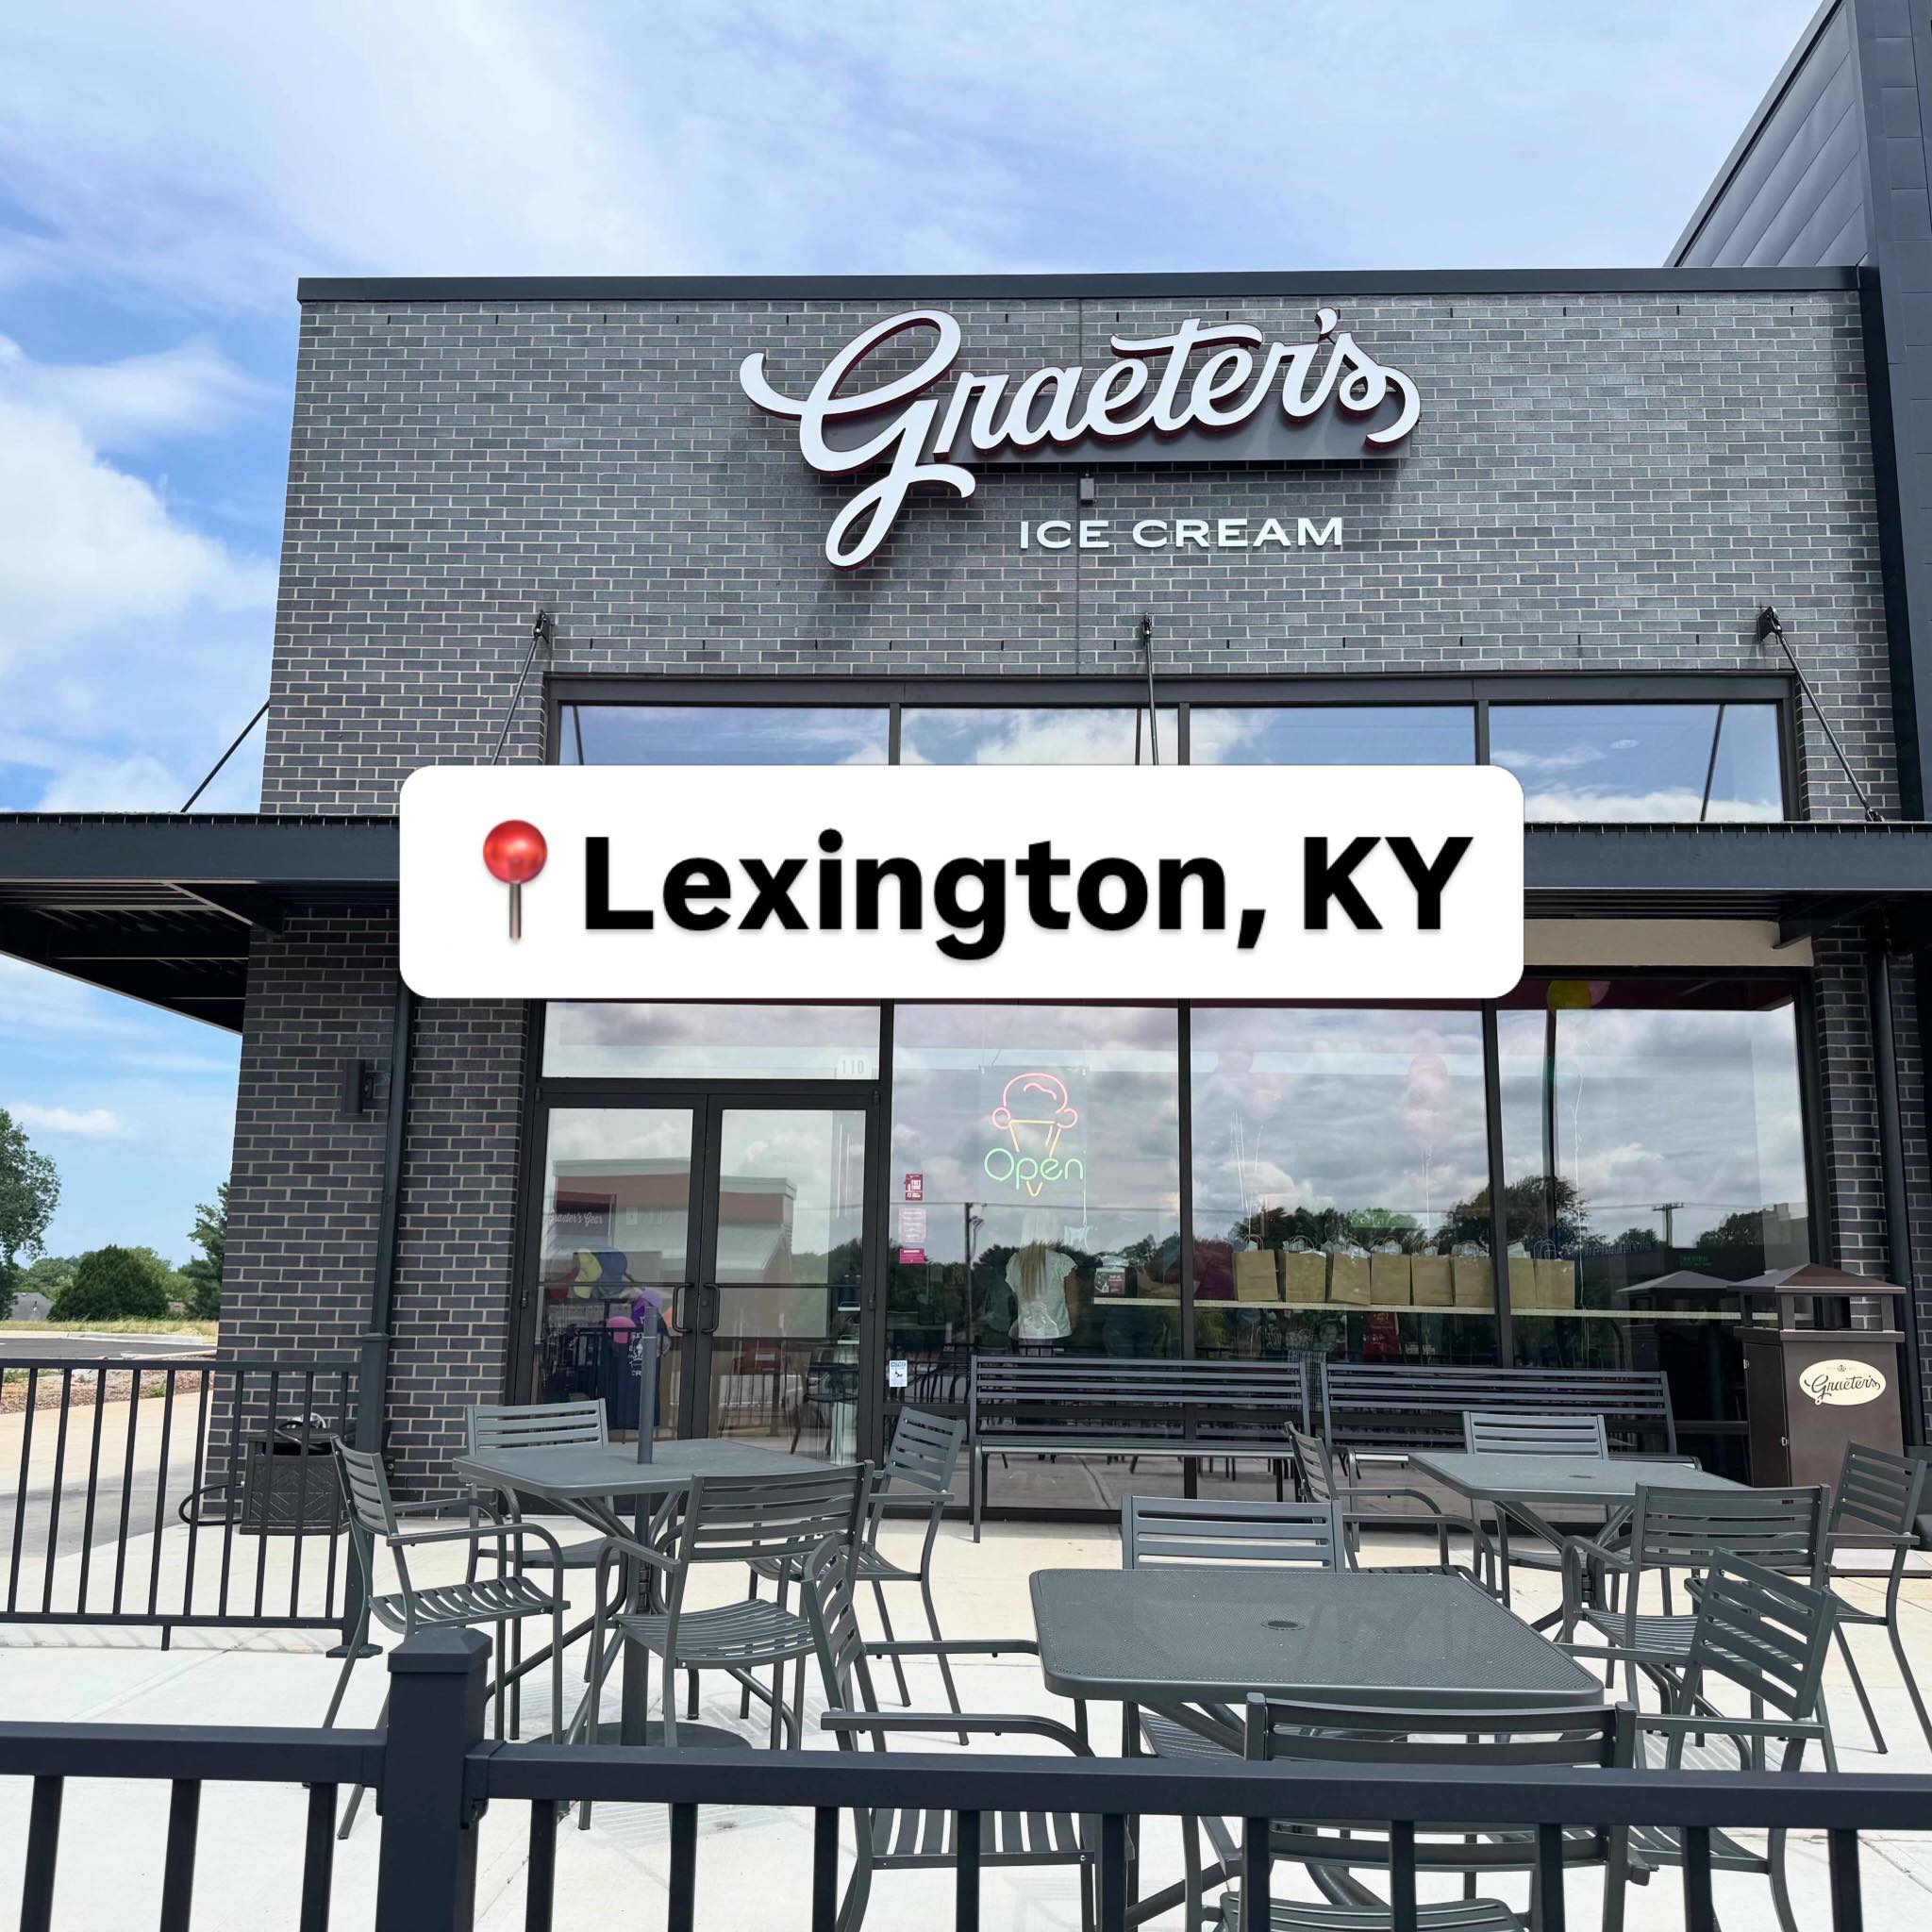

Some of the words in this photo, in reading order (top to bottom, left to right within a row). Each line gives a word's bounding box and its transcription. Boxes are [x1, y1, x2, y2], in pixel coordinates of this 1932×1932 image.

[740, 308, 1421, 567] Graeter's
[1020, 520, 1109, 549] ICE
[1132, 517, 1342, 547] CREAM
[841, 1058, 865, 1074] 110
[984, 1147, 1084, 1190] Open
[1803, 1374, 1881, 1405] Graeter's
